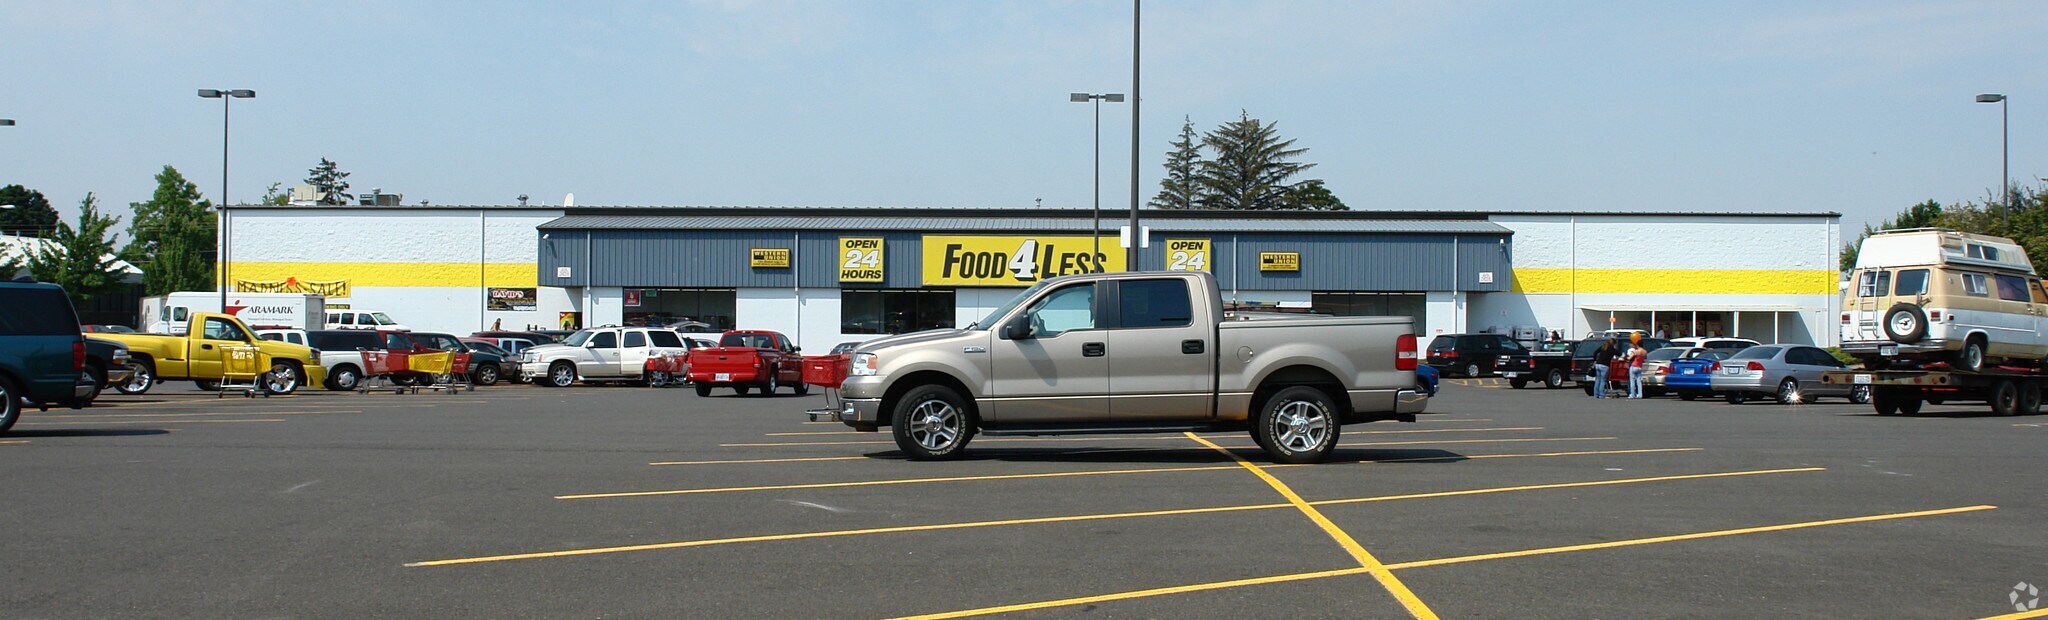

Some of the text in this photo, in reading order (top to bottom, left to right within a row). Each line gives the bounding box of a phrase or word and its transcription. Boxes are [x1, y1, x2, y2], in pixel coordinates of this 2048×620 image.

[845, 240, 878, 249] OPEN
[1171, 241, 1204, 250] OPEN
[843, 249, 880, 268] 24
[1169, 251, 1206, 271] 24
[841, 269, 882, 279] HOURS
[310, 281, 347, 296] SALE!
[247, 306, 294, 314] ARAMARK
